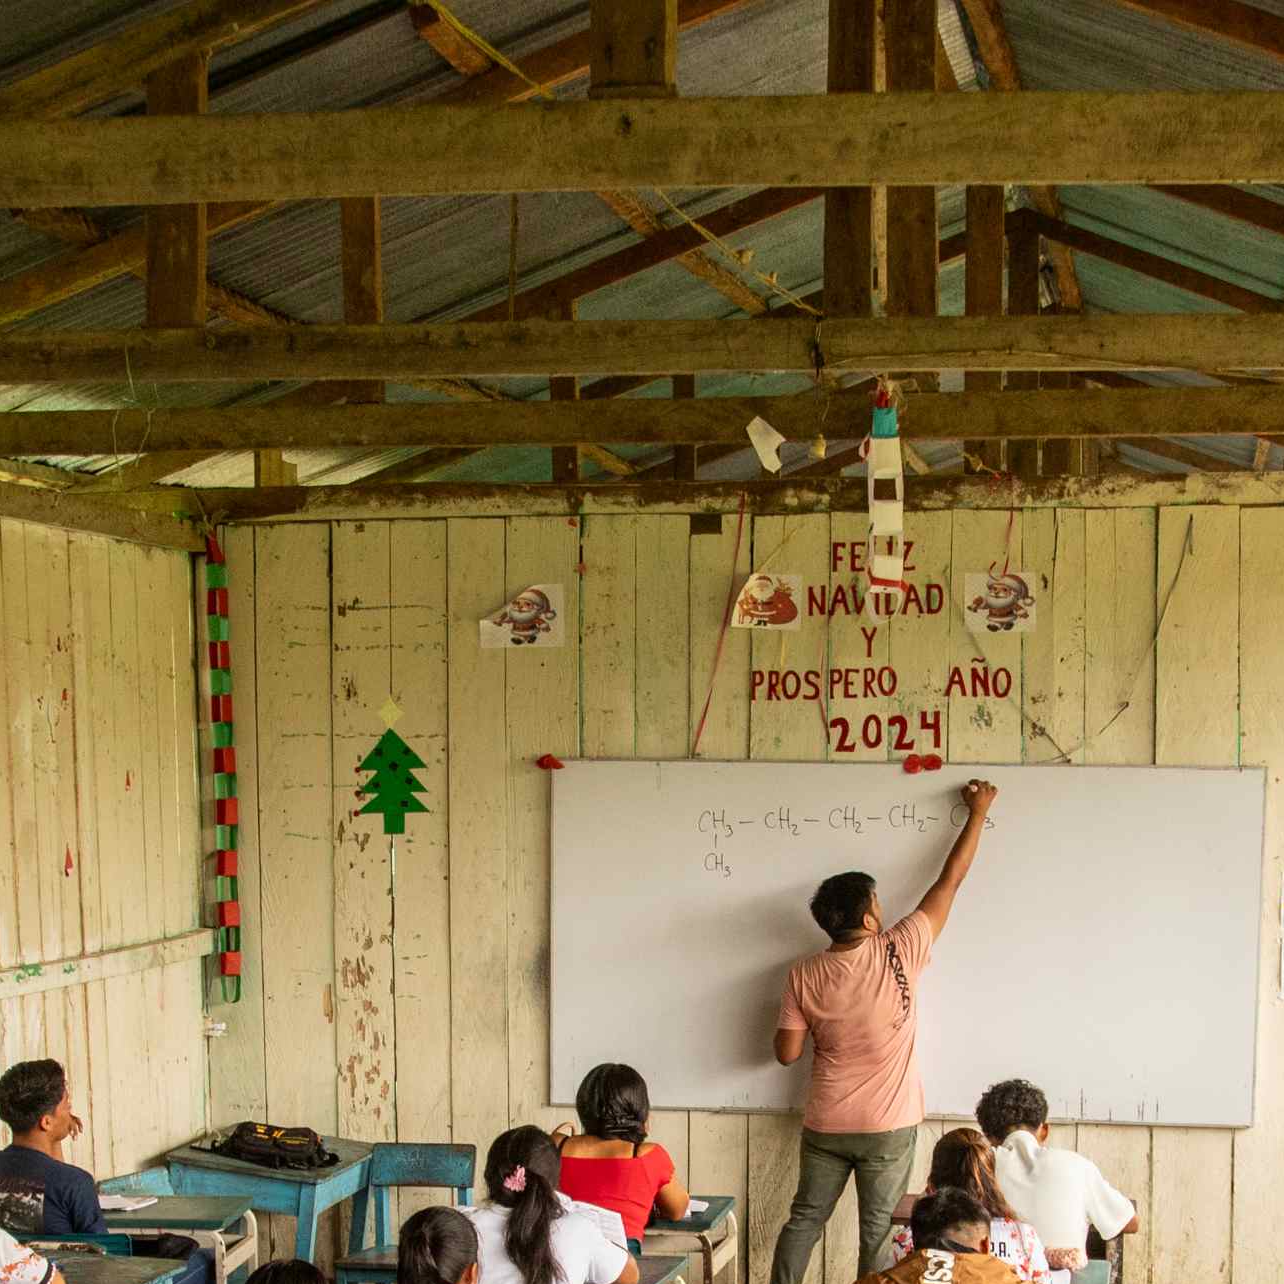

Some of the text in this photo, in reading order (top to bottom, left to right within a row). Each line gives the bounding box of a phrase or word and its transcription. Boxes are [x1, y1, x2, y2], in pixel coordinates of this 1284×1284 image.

[808, 584, 944, 616] NAVIDAD
[861, 626, 878, 657] Y
[751, 657, 1012, 700] PROSPERO AÑO
[830, 710, 942, 753] 2024
[949, 803, 996, 830] C3
